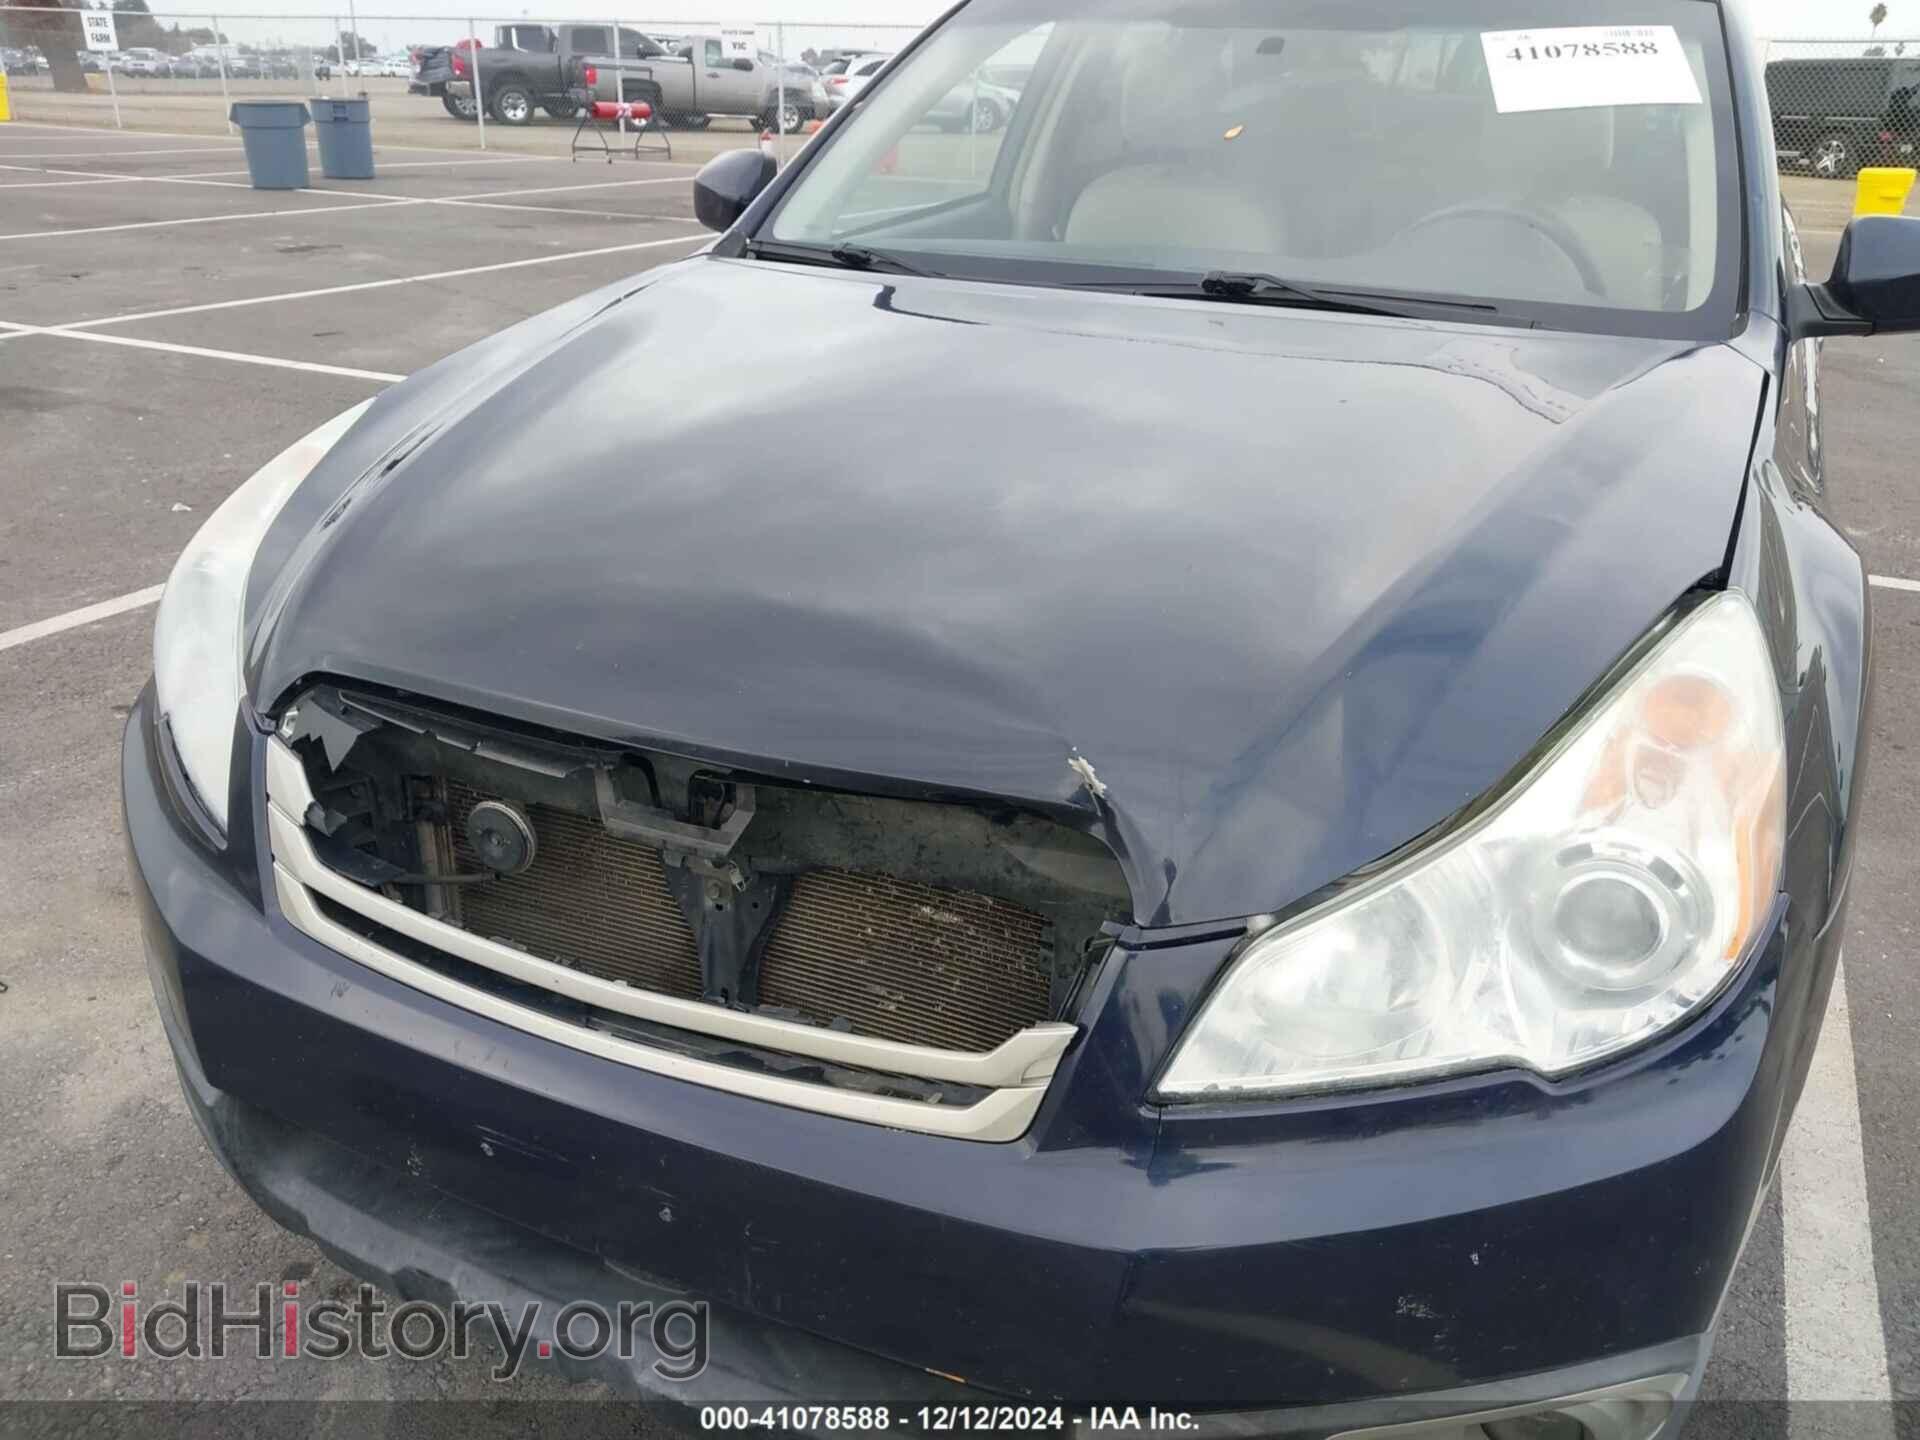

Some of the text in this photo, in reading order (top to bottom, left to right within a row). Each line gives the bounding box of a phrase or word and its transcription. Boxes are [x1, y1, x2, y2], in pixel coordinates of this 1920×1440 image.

[87, 16, 109, 28] STATE
[91, 32, 111, 43] FARM
[1505, 41, 1659, 61] 41078588
